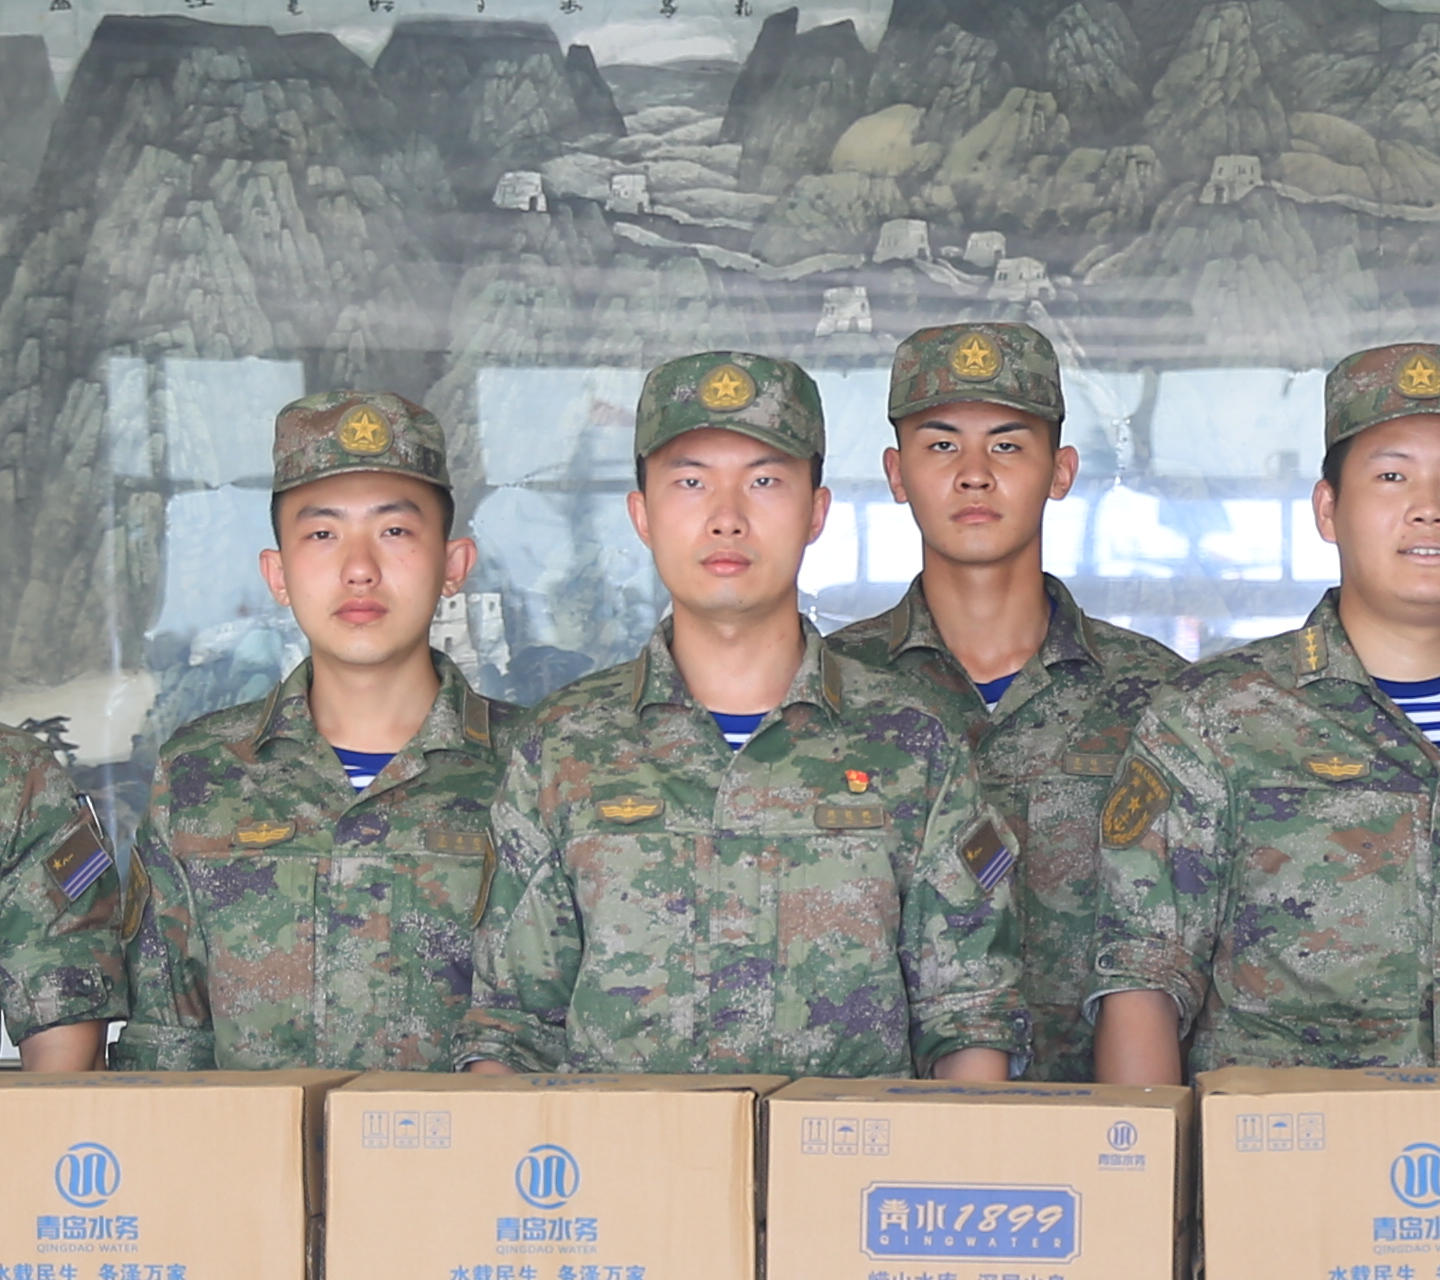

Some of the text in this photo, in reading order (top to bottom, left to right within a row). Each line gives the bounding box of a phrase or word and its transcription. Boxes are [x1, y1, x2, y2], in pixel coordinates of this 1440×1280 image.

[36, 1215, 139, 1240] 青岛水务
[496, 1217, 598, 1242] 青岛水务
